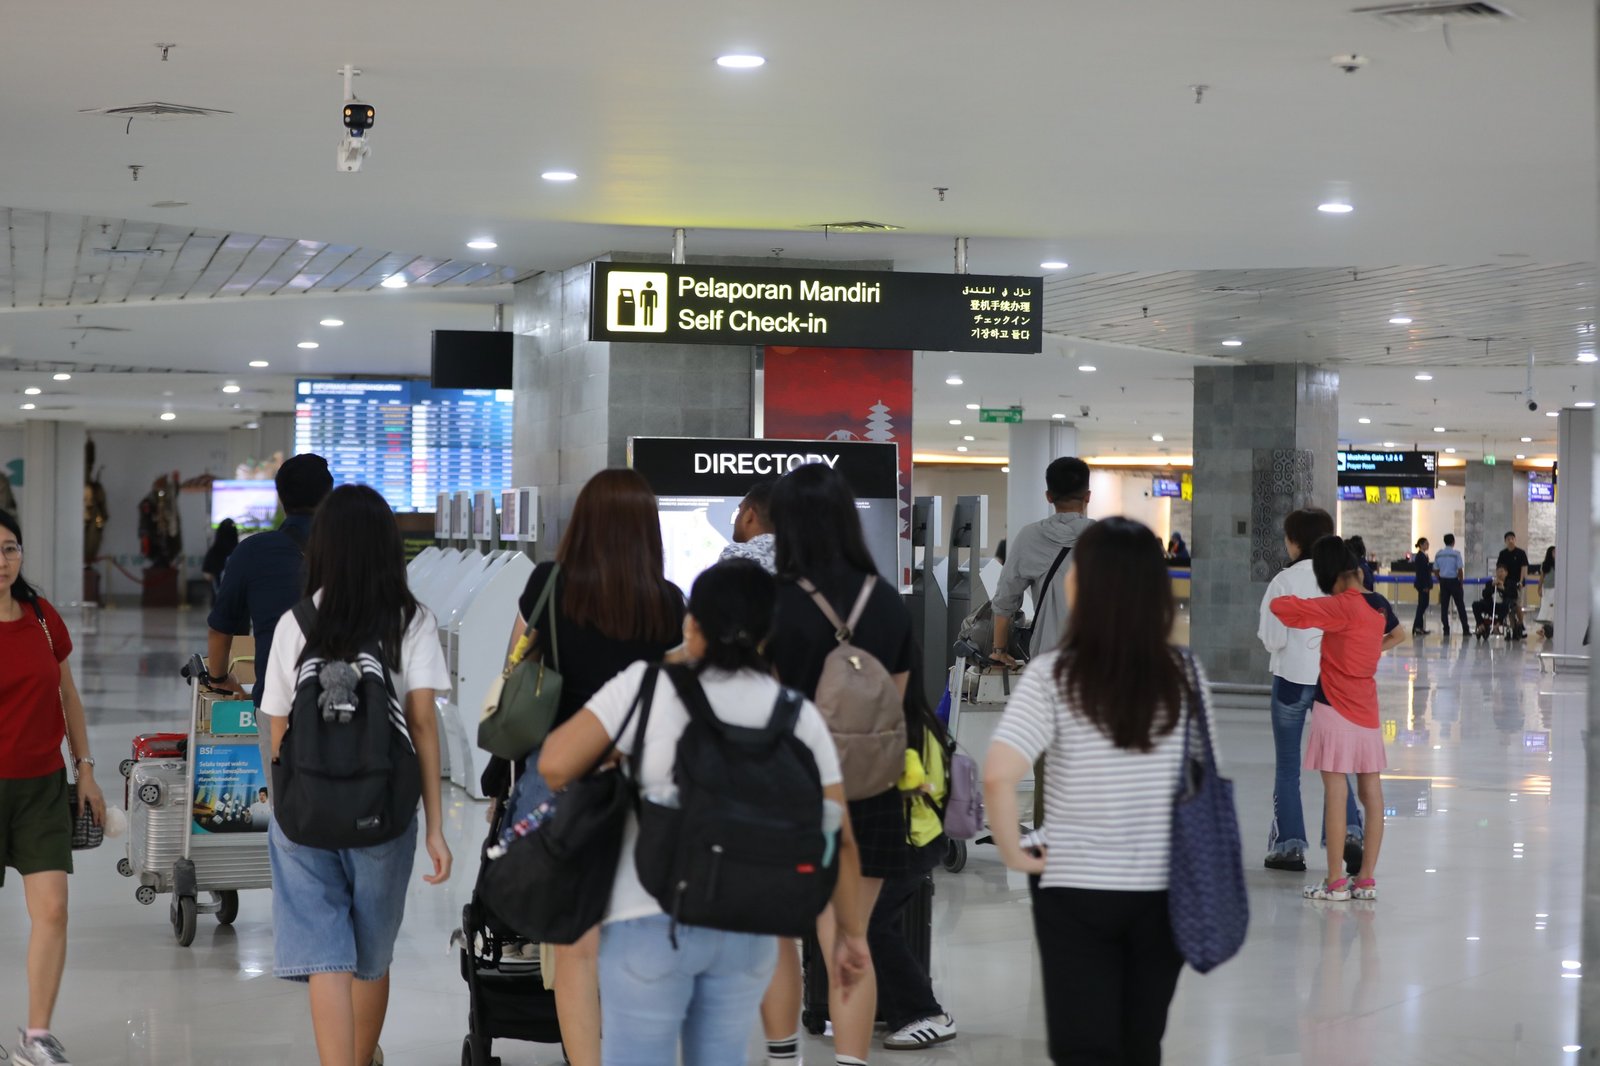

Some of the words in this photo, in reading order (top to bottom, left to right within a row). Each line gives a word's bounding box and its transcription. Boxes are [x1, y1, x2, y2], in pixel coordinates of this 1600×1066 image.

[678, 276, 792, 303] Pelaporan
[800, 280, 880, 303] Mandiri
[970, 299, 1031, 313] 登机手续办理
[678, 309, 724, 331] Self
[728, 310, 827, 333] Check-in
[973, 314, 1031, 326] チェックイン
[239, 711, 258, 728] B
